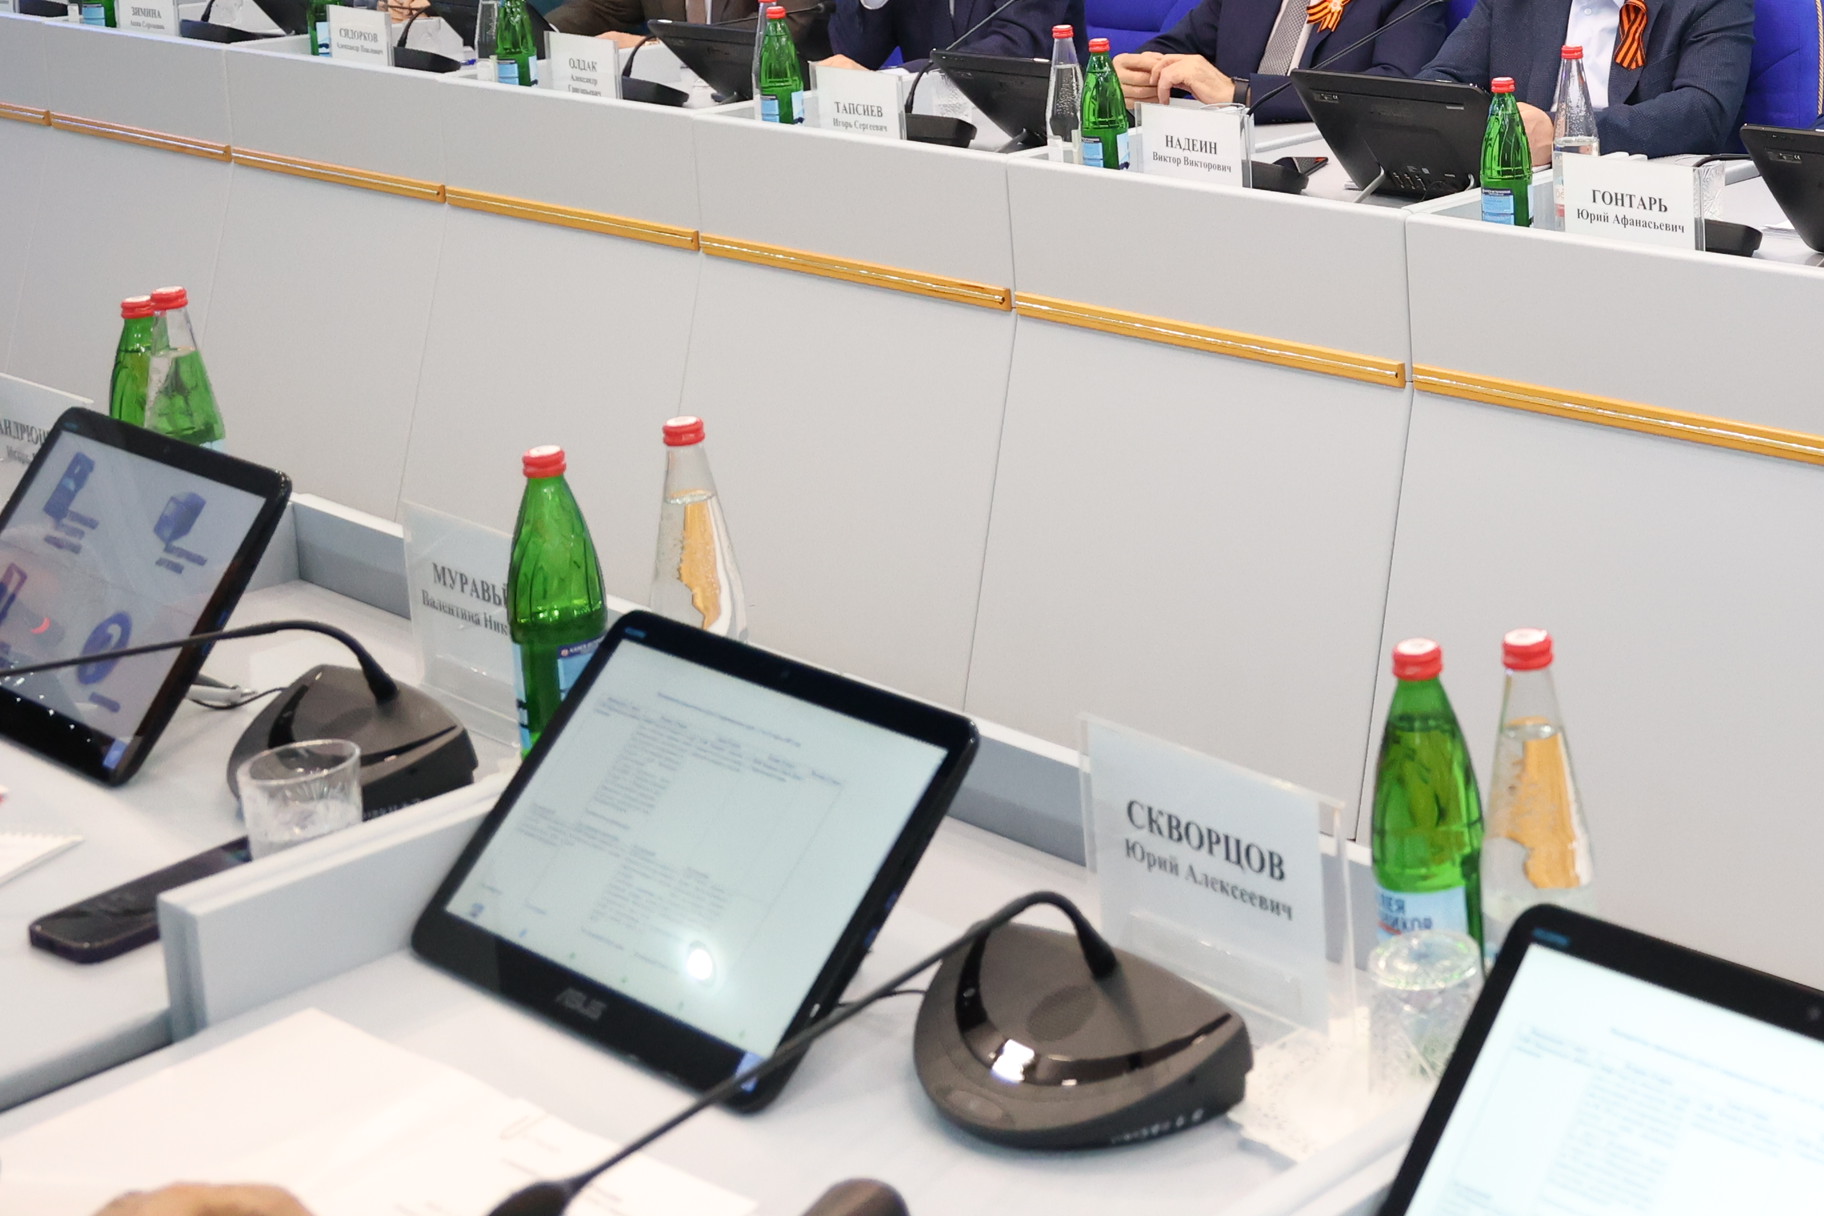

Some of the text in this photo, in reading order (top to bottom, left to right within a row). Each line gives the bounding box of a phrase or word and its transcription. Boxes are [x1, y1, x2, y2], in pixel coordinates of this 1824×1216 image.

[568, 58, 598, 72] ОЛДАК
[834, 101, 884, 118] ТАПСИЕВ
[833, 118, 888, 132] Игорь Сергеевич
[1165, 135, 1218, 155] НАДЕИН
[1152, 151, 1232, 173] Виктор Викторович
[1592, 189, 1668, 213] ГОНТАРЬ
[1577, 208, 1685, 233] Юрий Афанасьевич
[421, 589, 509, 636] Валентина Ник
[1126, 799, 1286, 882] СКВОРЦОВ
[1125, 838, 1293, 921] Юрий Алексеевич
